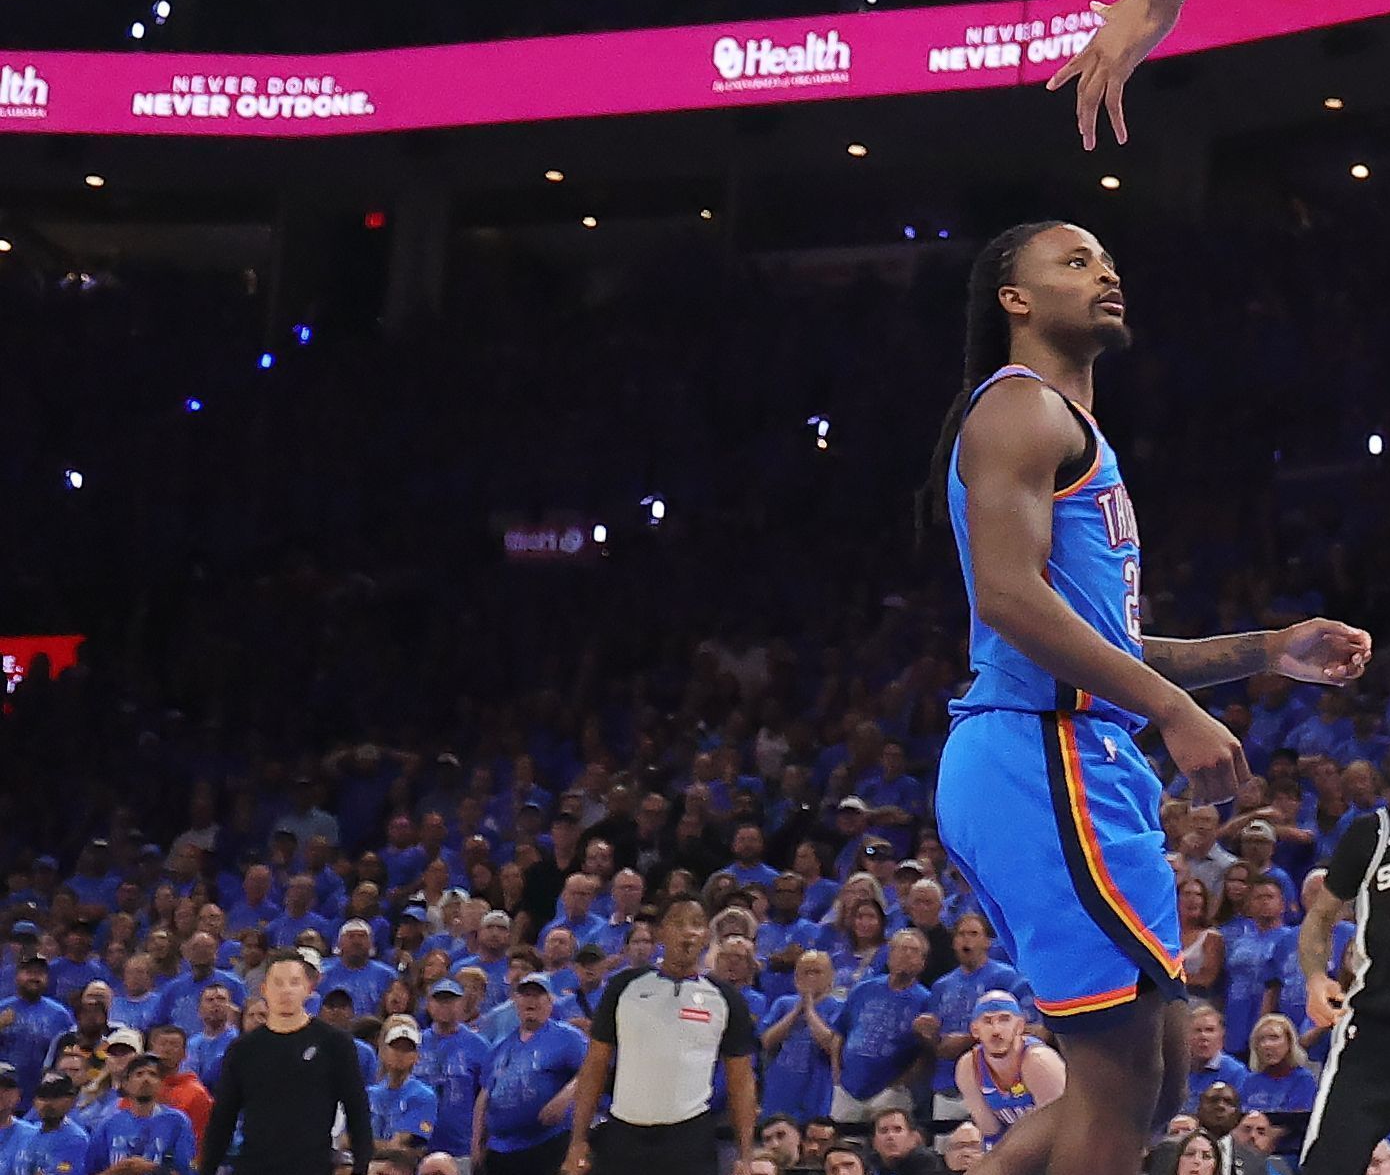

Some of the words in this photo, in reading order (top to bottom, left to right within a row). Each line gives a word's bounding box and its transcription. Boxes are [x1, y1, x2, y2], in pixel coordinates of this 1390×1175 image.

[965, 20, 1045, 45] NEVER
[744, 30, 851, 77] Health
[928, 42, 1022, 73] NEVER
[0, 64, 49, 106] lth
[172, 75, 258, 94] NEVER
[267, 75, 342, 94] DONE.
[132, 92, 232, 118] NEVER
[235, 90, 376, 119] OUTDONE.
